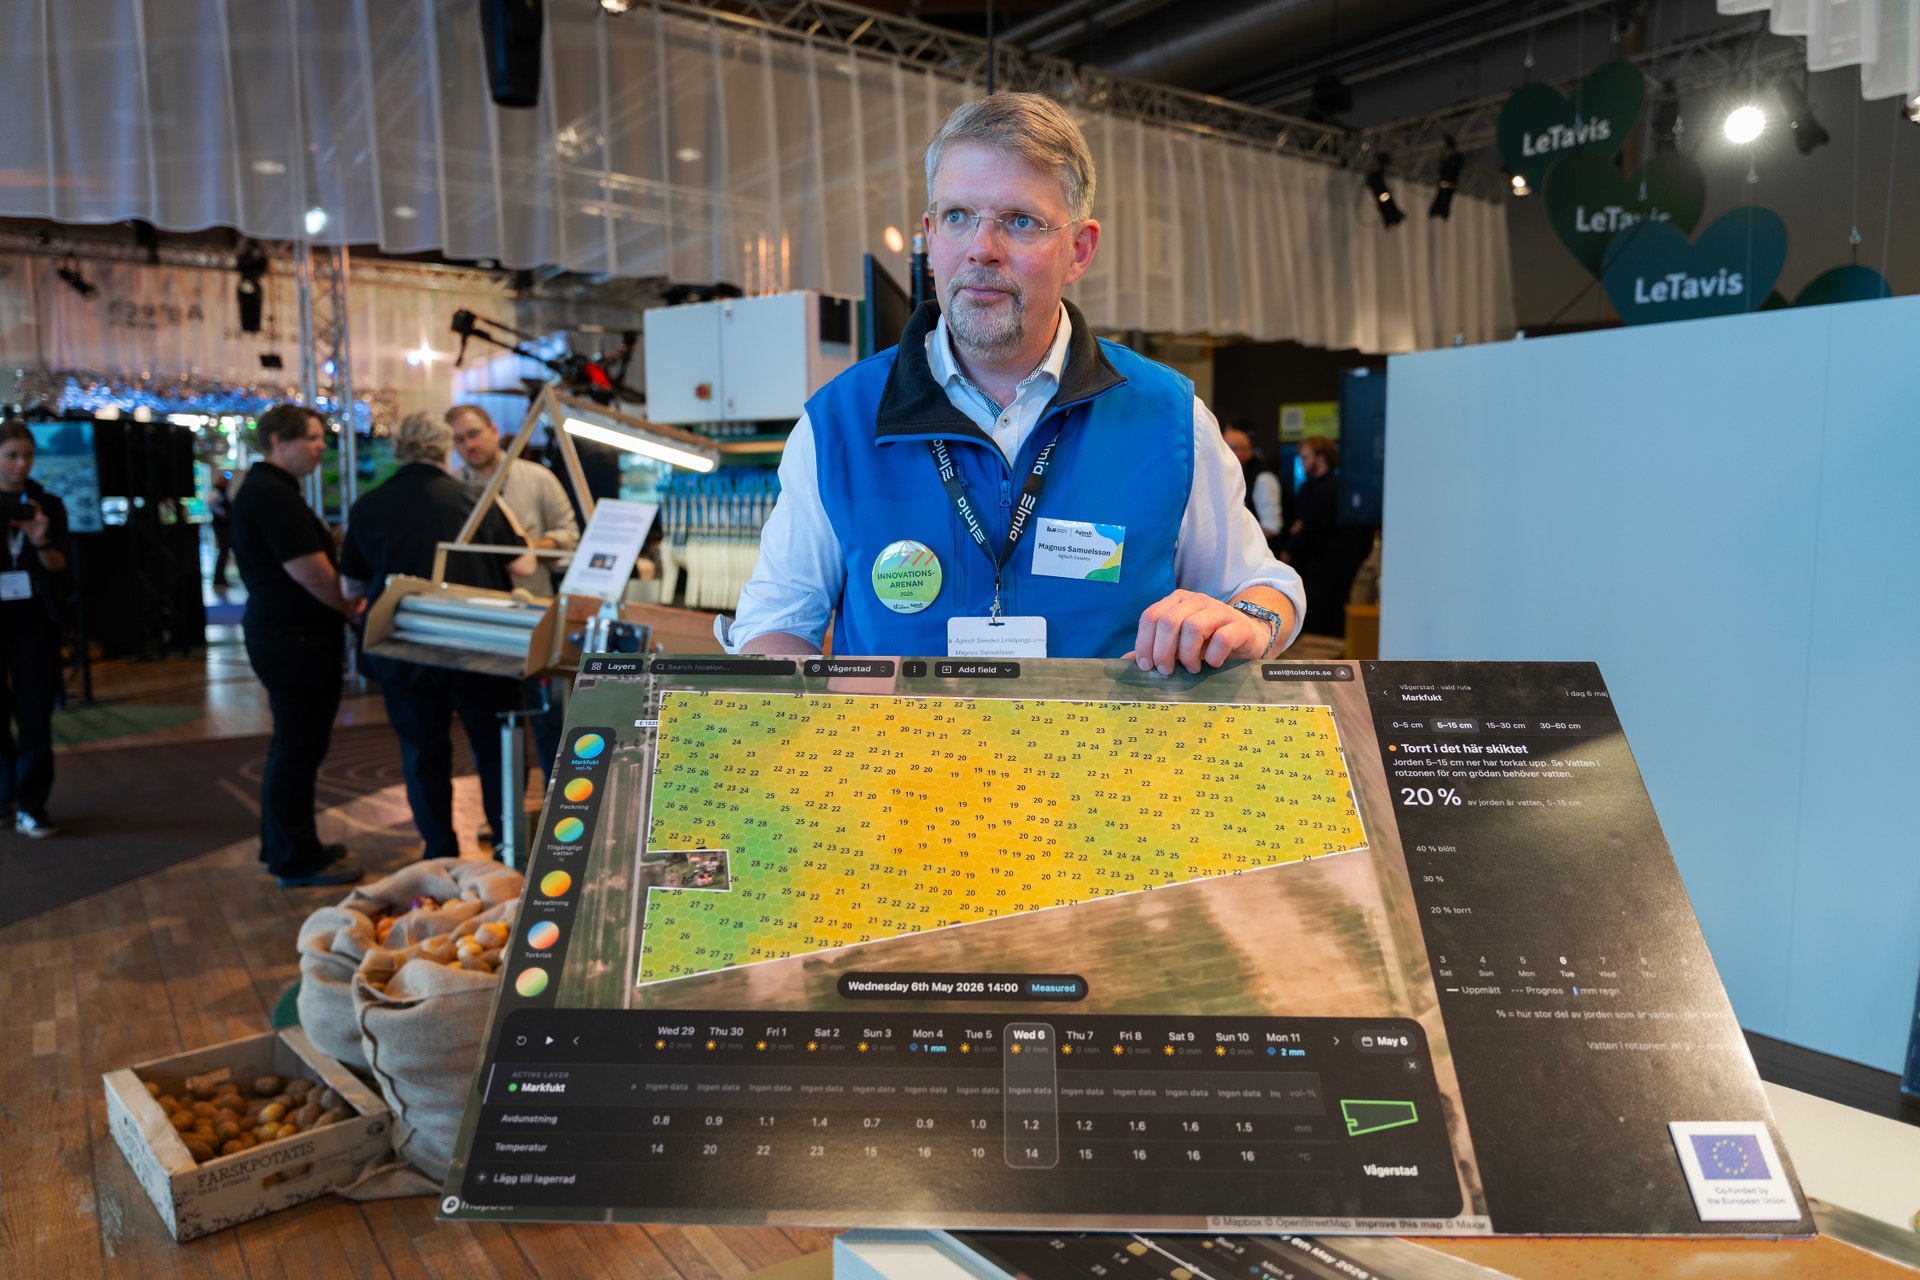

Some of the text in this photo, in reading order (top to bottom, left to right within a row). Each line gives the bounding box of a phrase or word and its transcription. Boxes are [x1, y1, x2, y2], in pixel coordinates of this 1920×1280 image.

[1522, 116, 1611, 157] LeTavis
[1634, 267, 1744, 304] LeTavis
[957, 495, 986, 545] Elmia
[1009, 493, 1036, 542] Elmia
[1038, 542, 1111, 556] Magnus Samuelsson
[877, 569, 935, 580] INNOVATIONS-
[890, 580, 924, 588] ARENAN
[607, 662, 636, 671] Layers
[667, 663, 694, 671] Search
[827, 664, 871, 673] Vågerstad
[958, 666, 975, 674] Add
[1268, 669, 1331, 677] axel@tolefors.se
[1401, 693, 1442, 701] Markfukt
[1570, 690, 1585, 698] dag
[1400, 743, 1528, 754] Torrt i det här skiktet
[1483, 759, 1497, 767] har
[1500, 759, 1527, 767] torkat
[1529, 761, 1549, 769] upp.
[1395, 769, 1435, 777] rotzonen
[1436, 769, 1449, 777] för
[1468, 769, 1501, 779] grödan
[1502, 769, 1539, 777] behöver
[1541, 770, 1573, 778] vatten.
[1400, 787, 1462, 806] 20 %
[1478, 799, 1504, 807] jorden
[1438, 844, 1457, 852] blött
[1430, 906, 1472, 914] 20 % torrt
[1439, 955, 1446, 964] 3
[1479, 956, 1486, 964] 4
[1519, 956, 1526, 964] 5
[1559, 956, 1567, 965] 6
[1439, 969, 1452, 977] Sat
[1560, 970, 1575, 978] Tue
[848, 981, 1076, 993] Wednesday 6th May 2026 14:00 Measured
[1461, 986, 1501, 995] Uppmätt
[1525, 986, 1564, 997] Prognos
[1599, 988, 1620, 997] regn
[1495, 1010, 1506, 1018] %
[1516, 1010, 1531, 1018] hur
[1534, 1010, 1552, 1018] stor
[1554, 1010, 1569, 1018] del
[1582, 1011, 1612, 1020] jorden
[657, 1026, 695, 1035] Wed 29
[912, 1029, 943, 1038] Mon 4
[1013, 1030, 1046, 1040] Wed 6
[1266, 1033, 1300, 1042] Mon 11
[1377, 1036, 1408, 1048] May 6
[1280, 1048, 1287, 1056] 2
[521, 1083, 566, 1093] Markfukt
[501, 1114, 558, 1125] Avdunstning
[759, 1116, 775, 1126] 1.1
[1182, 1121, 1199, 1132] 1.6
[495, 1142, 548, 1153] Temperatur
[650, 1144, 664, 1153] 14
[1241, 1151, 1255, 1161] 16
[1363, 1163, 1418, 1178] Vågerstad
[493, 1174, 576, 1184] Lägg till lagerrad
[1355, 1219, 1442, 1230] Improve this map
